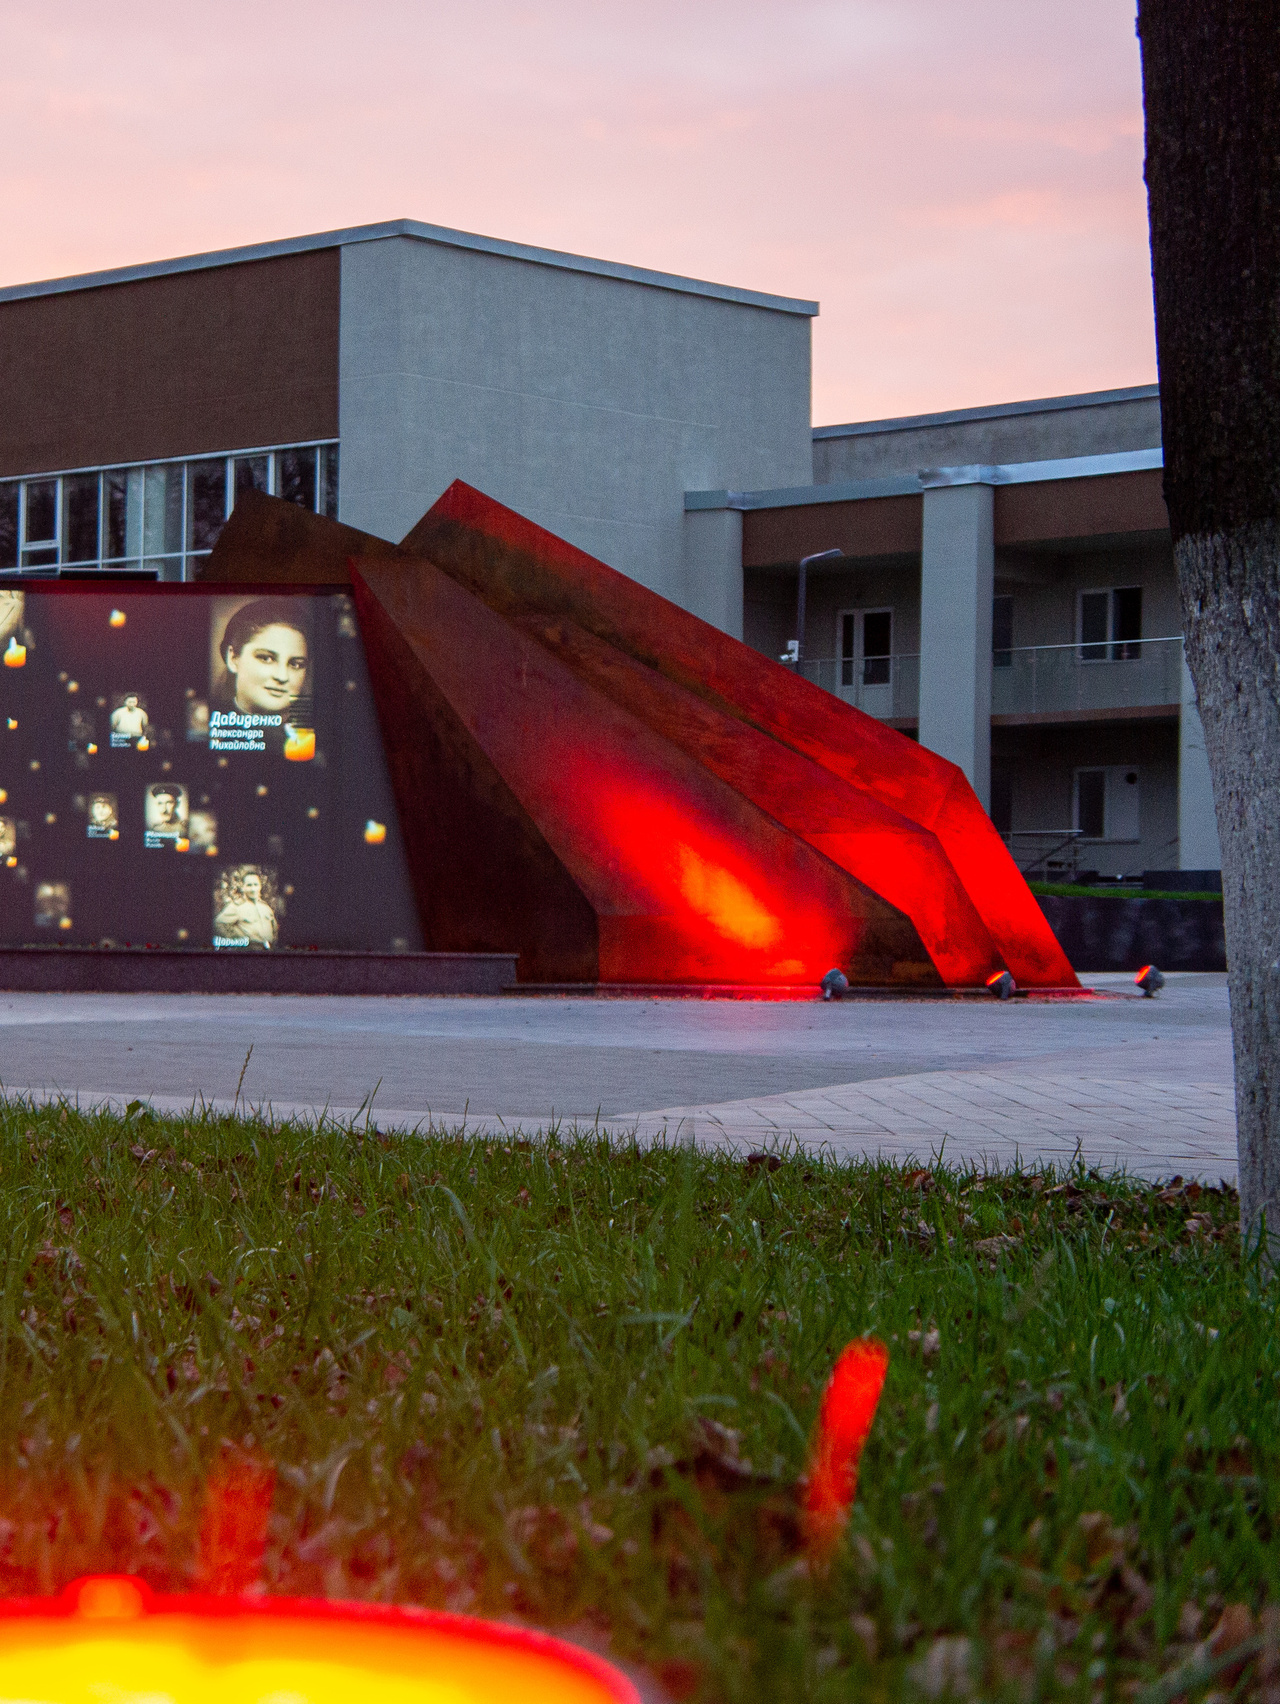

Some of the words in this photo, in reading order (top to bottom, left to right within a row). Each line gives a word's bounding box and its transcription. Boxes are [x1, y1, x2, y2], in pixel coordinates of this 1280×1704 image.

[209, 711, 282, 729] Давиденко
[209, 728, 264, 739] Александра
[209, 740, 266, 751] Михайловна
[213, 936, 250, 950] Царьков
